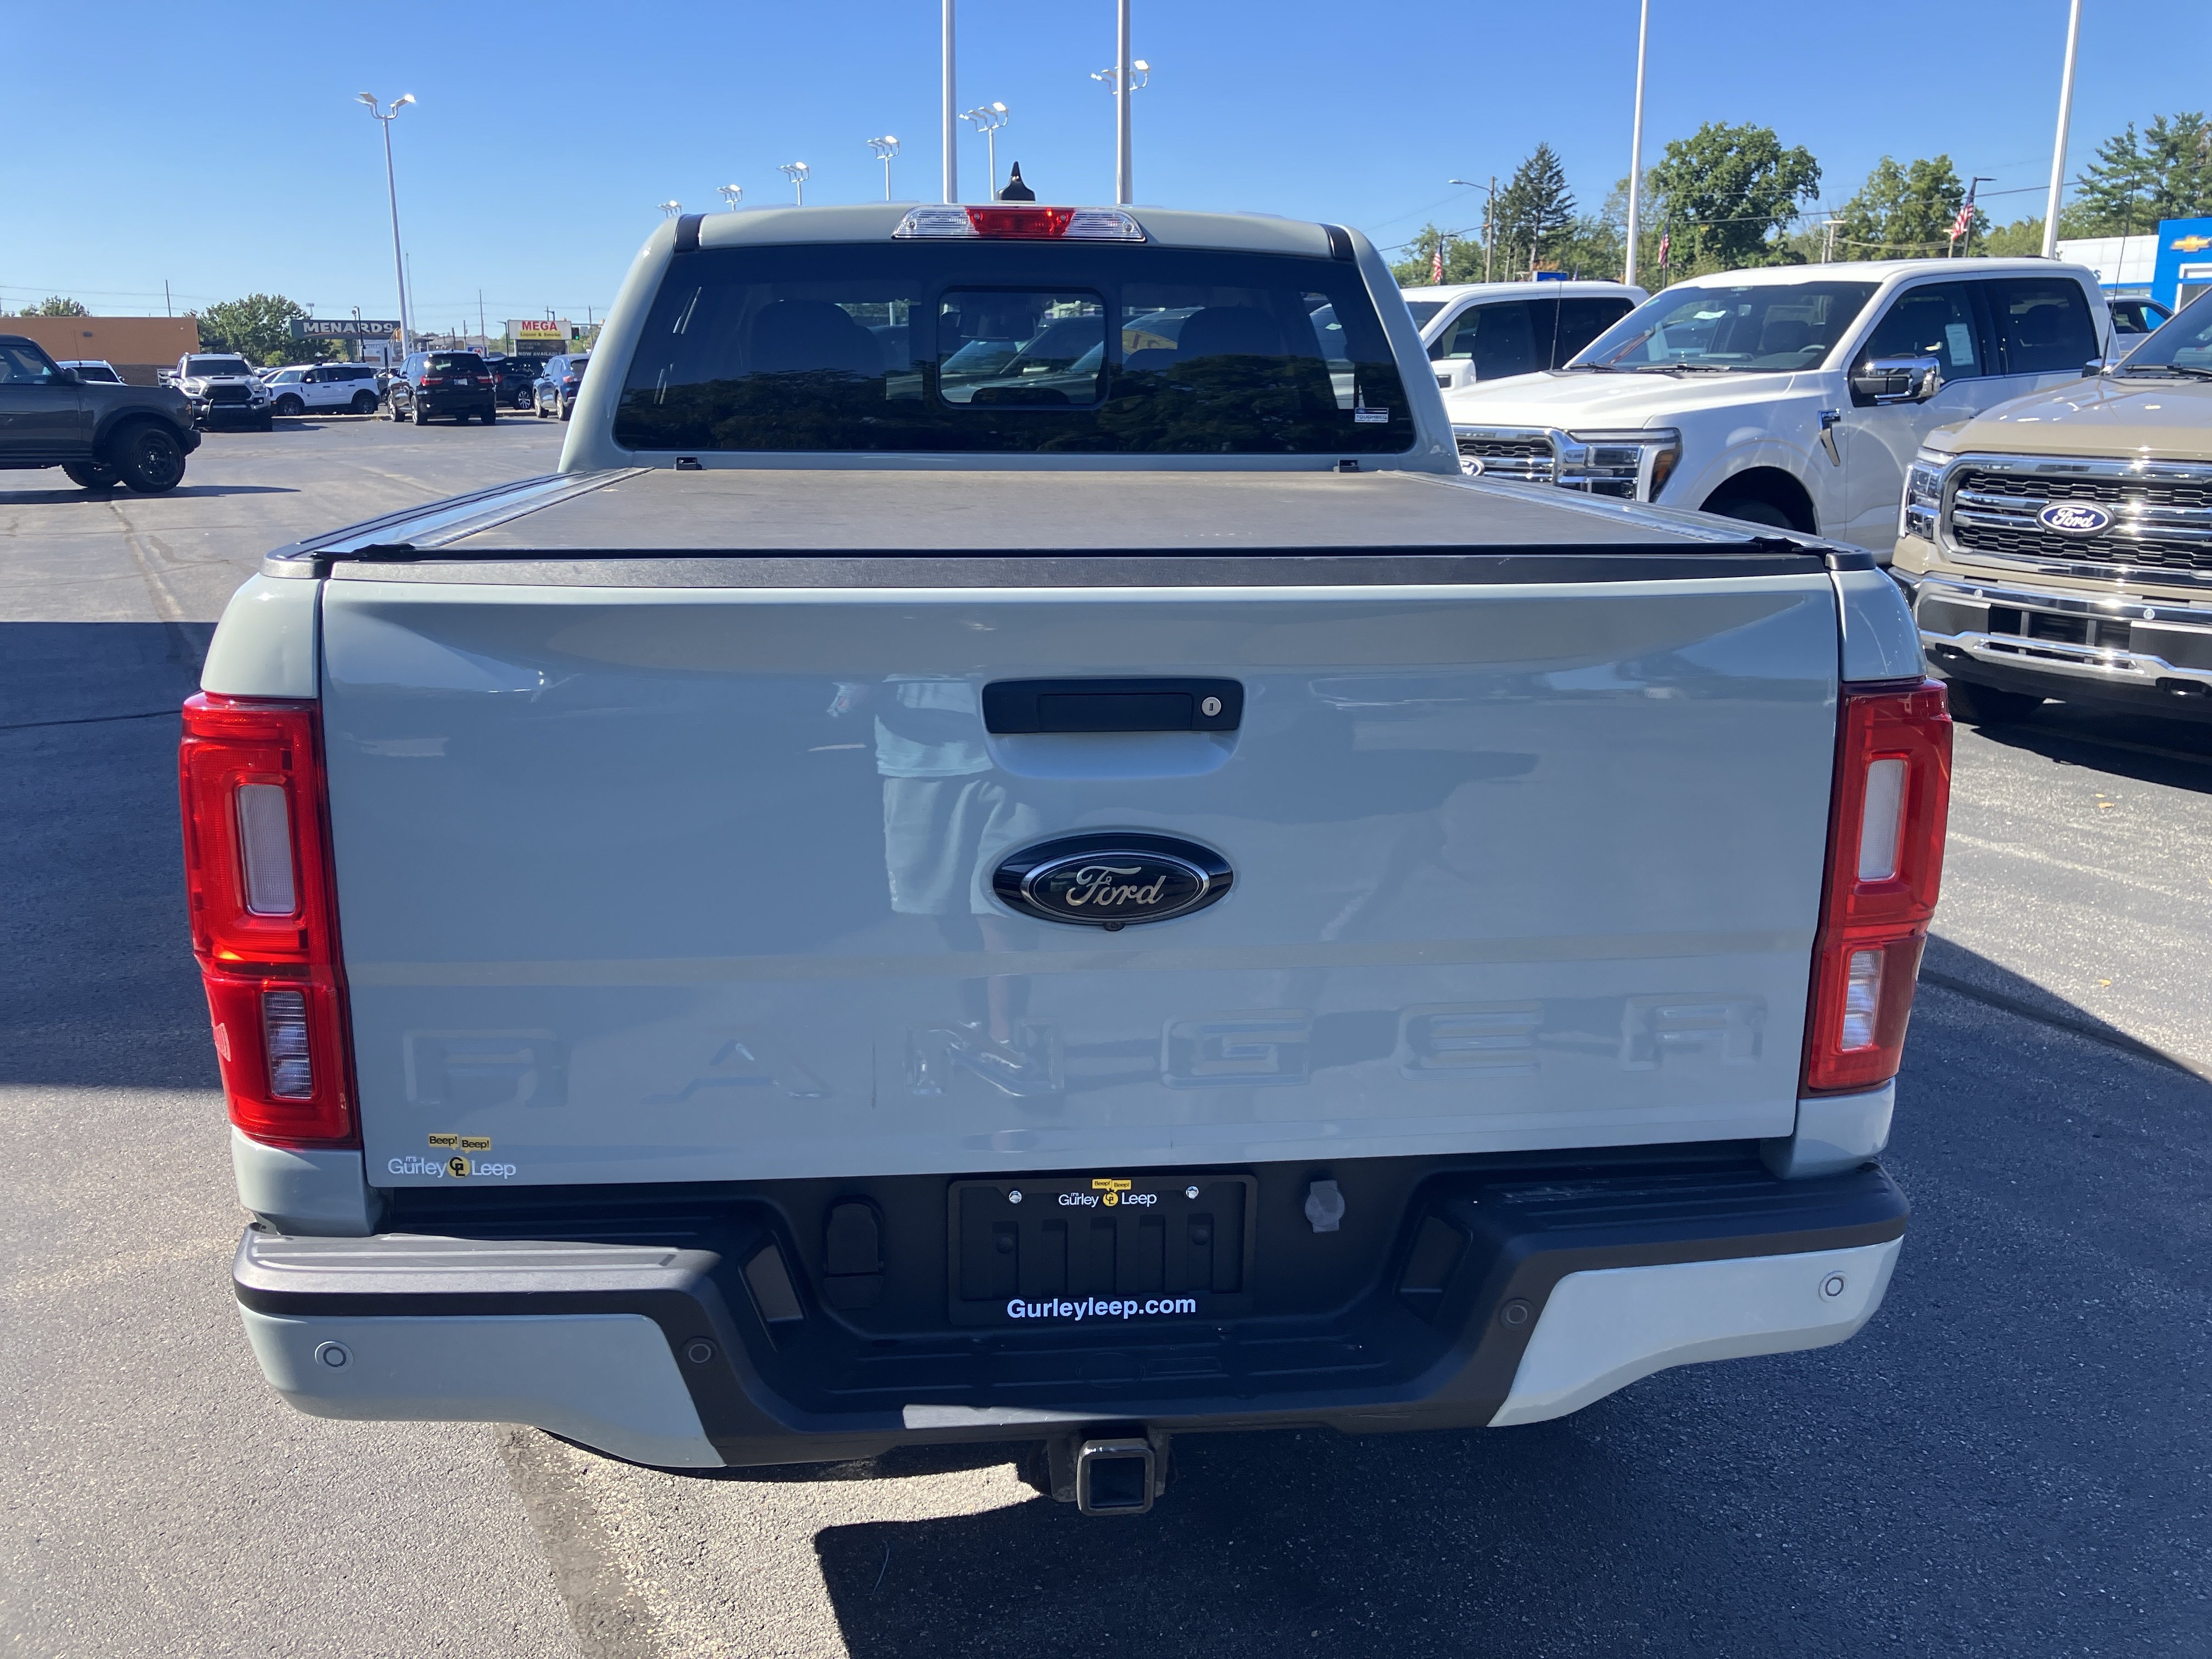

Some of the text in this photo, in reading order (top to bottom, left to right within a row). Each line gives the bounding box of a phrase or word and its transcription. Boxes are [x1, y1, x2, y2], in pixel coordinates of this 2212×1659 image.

[302, 322, 394, 334] MENARDS
[522, 320, 558, 331] MEGA
[2052, 507, 2096, 527] Ford
[1065, 866, 1167, 906] Ford
[430, 1136, 490, 1150] Beep! Beep!
[387, 1158, 448, 1178] Gurley
[471, 1160, 517, 1180] Leep
[1058, 1192, 1099, 1208] Gurley
[1121, 1192, 1158, 1207] Leep
[1007, 1297, 1197, 1321] Gurleyleep.com
